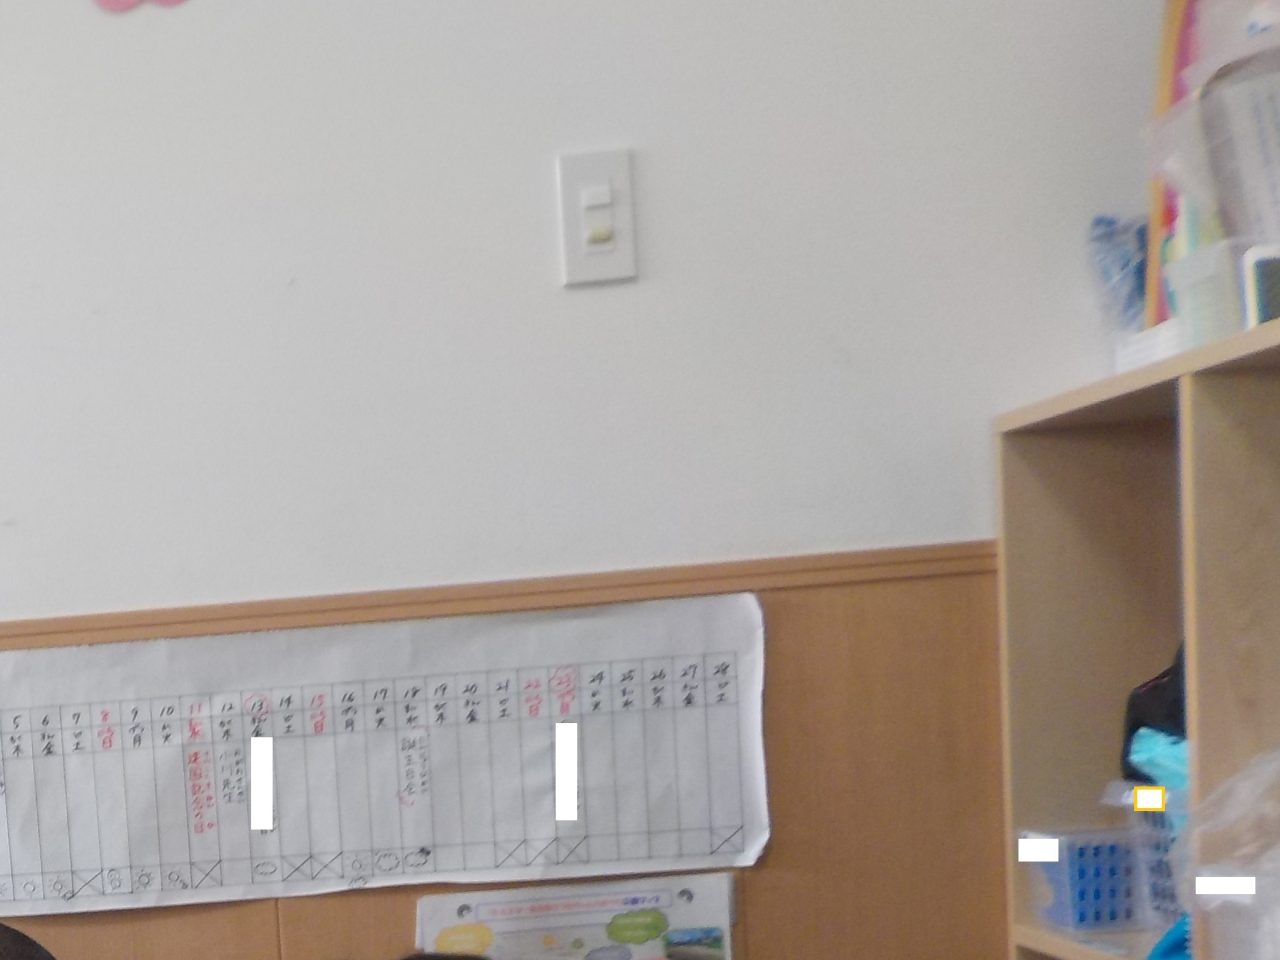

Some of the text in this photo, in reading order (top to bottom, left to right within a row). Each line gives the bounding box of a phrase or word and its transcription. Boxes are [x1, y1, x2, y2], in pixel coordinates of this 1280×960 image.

[650, 668, 666, 681] 26
[680, 663, 698, 680] 27
[589, 671, 604, 686] 24
[434, 682, 448, 697] 19
[462, 683, 479, 695] 20
[496, 679, 510, 692] 21
[341, 692, 355, 703] 16
[373, 688, 388, 701] 17
[403, 686, 421, 699] 18
[221, 703, 234, 712] 12
[251, 700, 264, 712] 13
[279, 695, 293, 708] 14
[72, 712, 81, 725] 7
[131, 707, 139, 722] 9
[159, 706, 175, 718] 10
[12, 715, 21, 730] 5
[41, 714, 50, 727] 6
